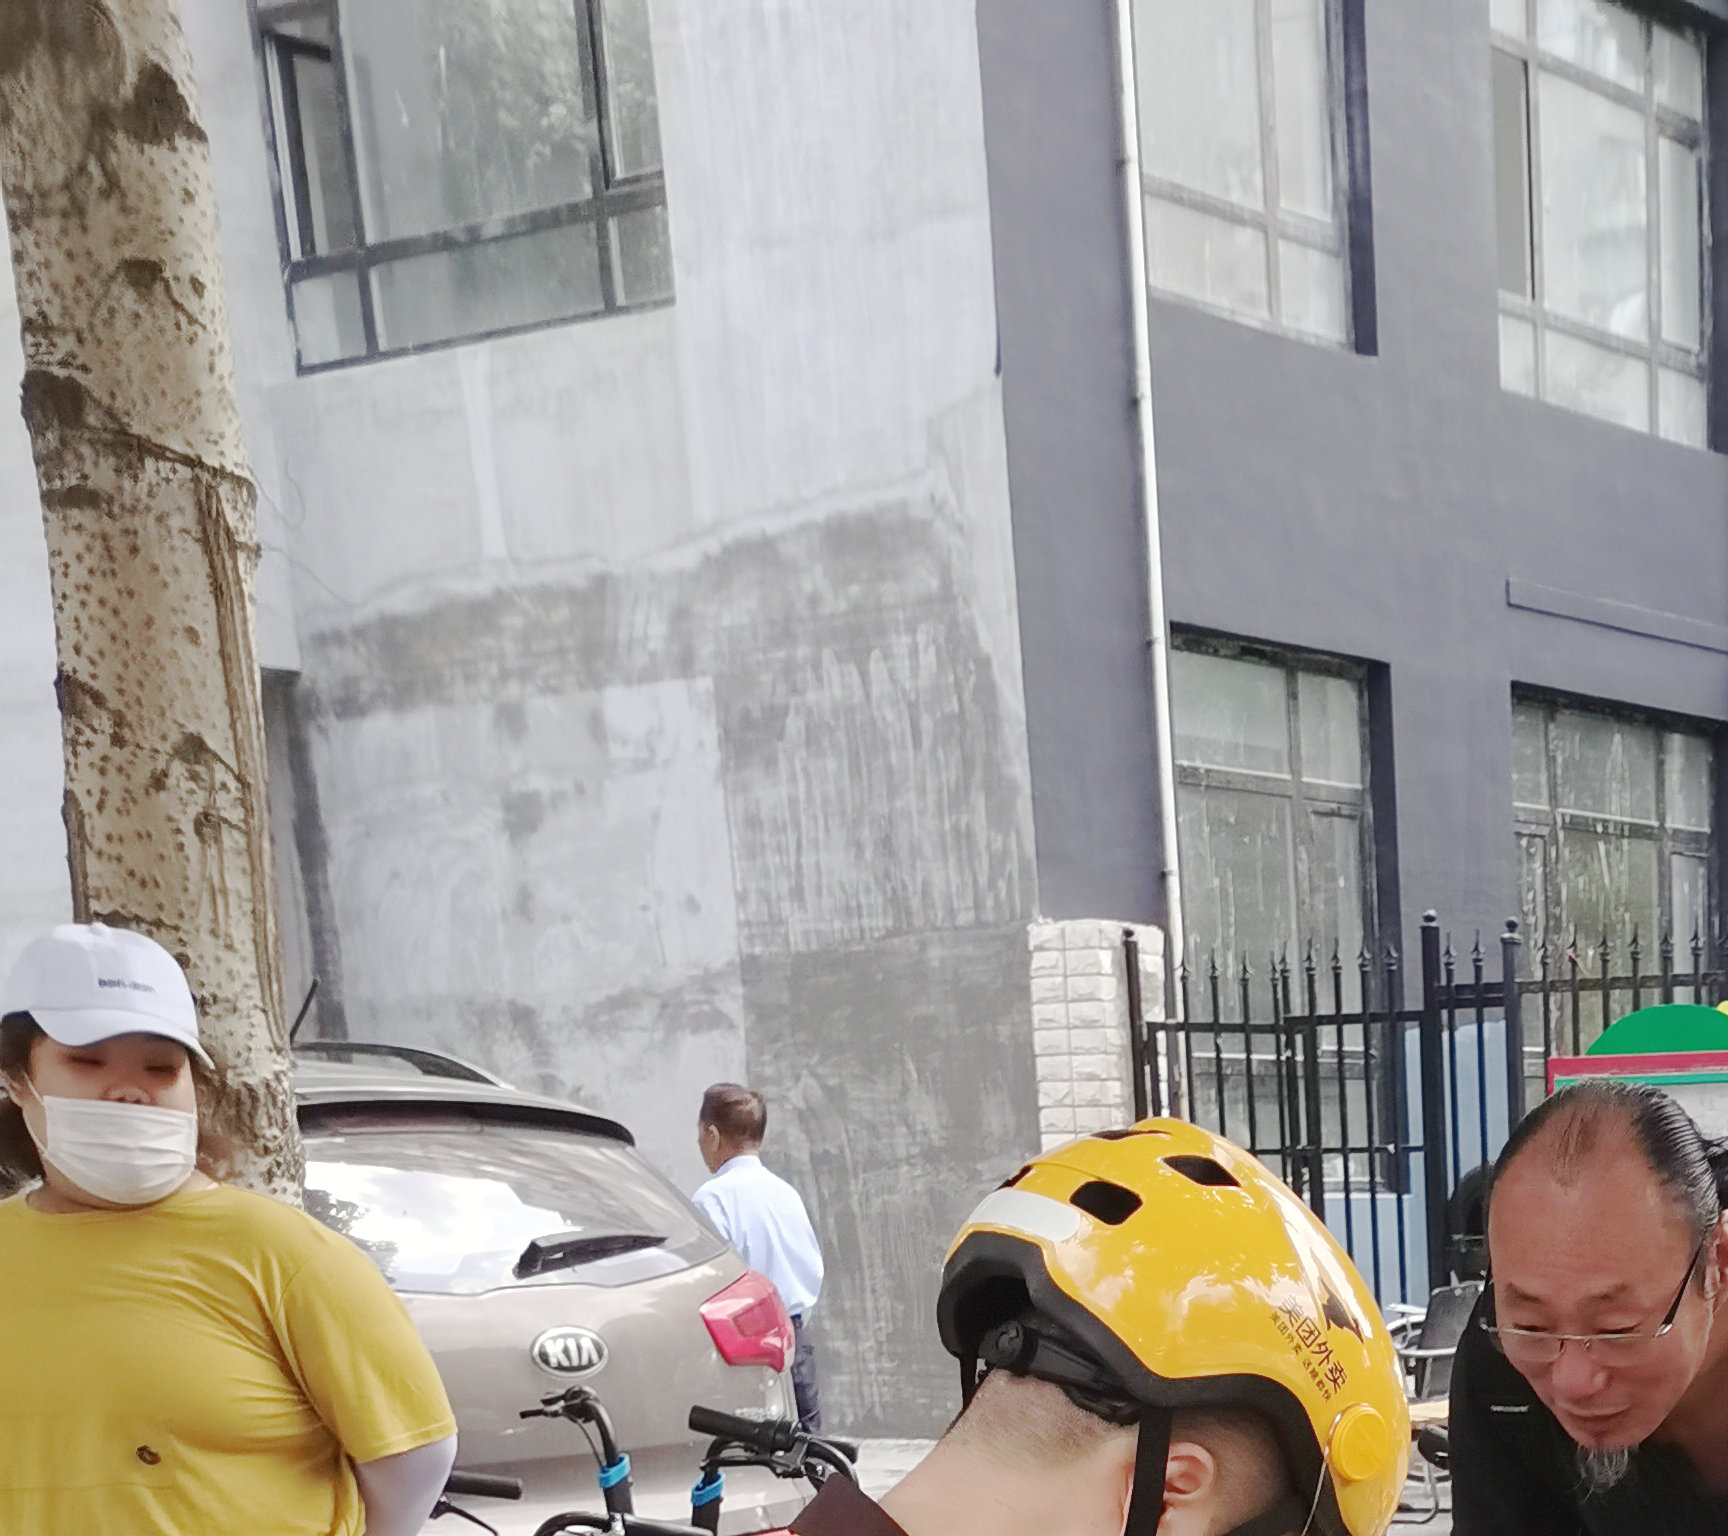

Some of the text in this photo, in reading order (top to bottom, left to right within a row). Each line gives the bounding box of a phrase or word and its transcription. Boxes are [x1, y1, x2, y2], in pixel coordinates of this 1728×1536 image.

[542, 1336, 600, 1368] KIA
[1279, 1294, 1348, 1394] 美团外卖
